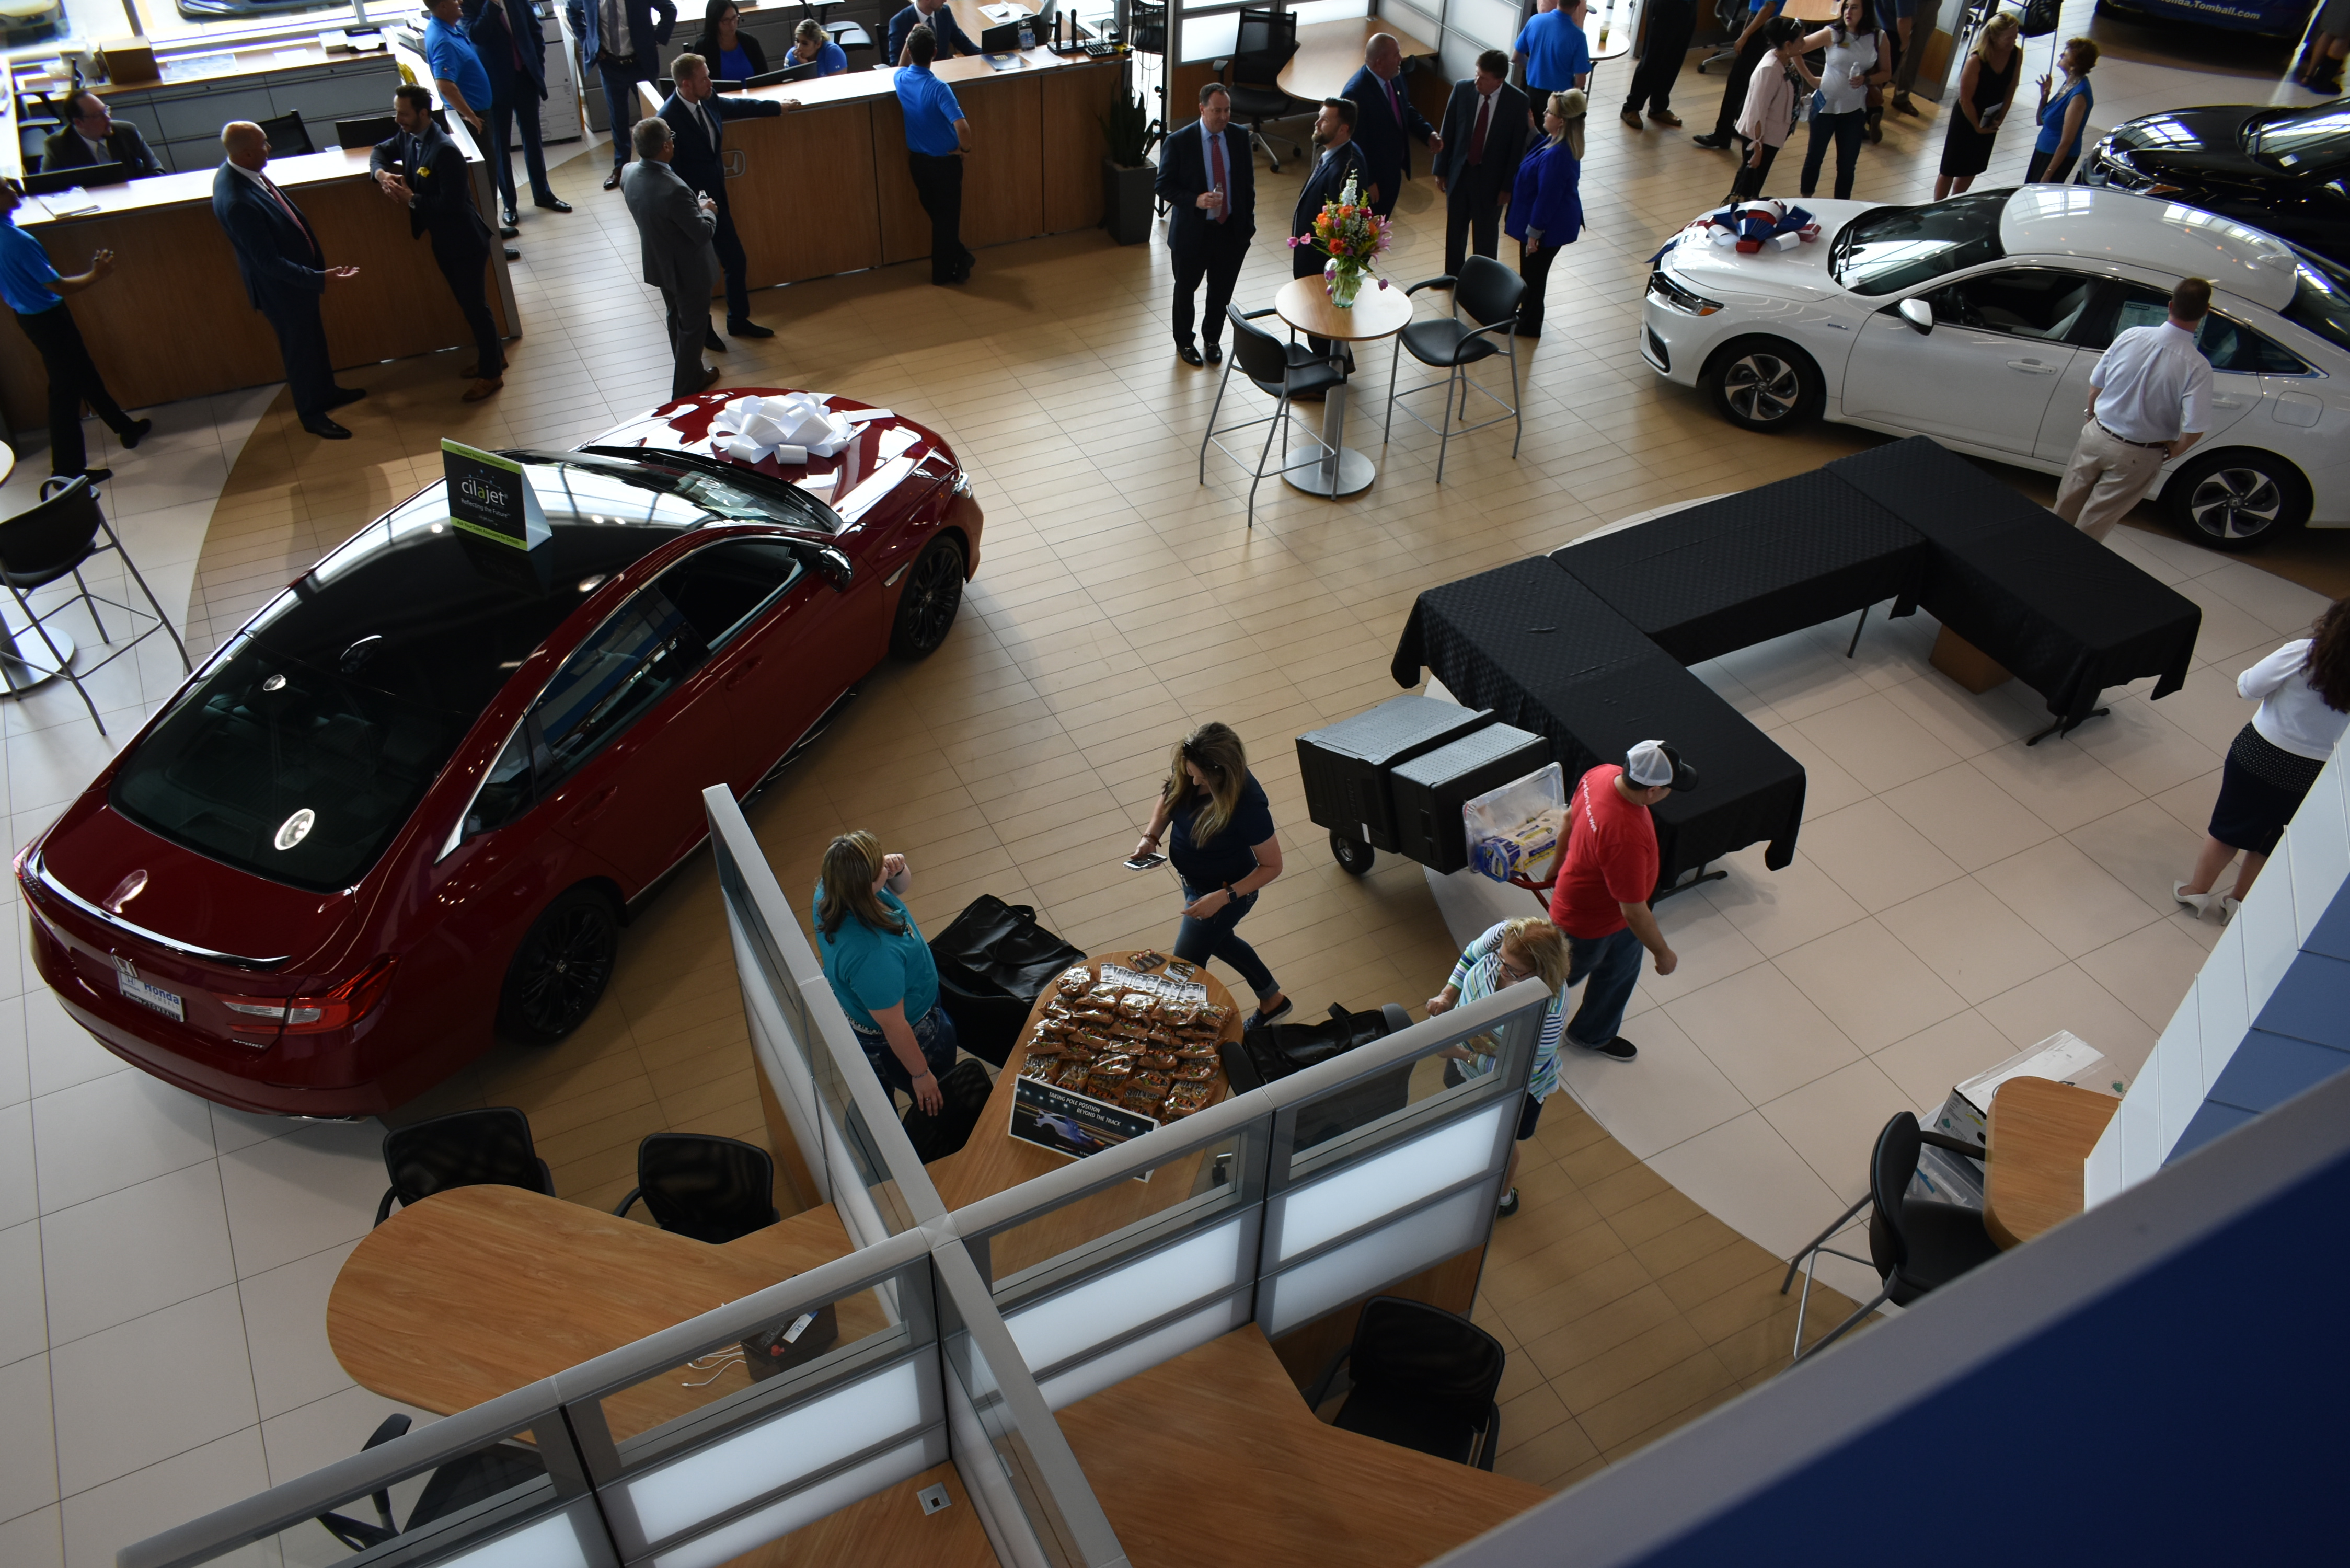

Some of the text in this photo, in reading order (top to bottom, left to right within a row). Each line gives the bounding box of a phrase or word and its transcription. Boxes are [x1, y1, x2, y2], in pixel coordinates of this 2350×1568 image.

[461, 498, 484, 511] Reflecting
[482, 527, 501, 538] Associate
[506, 536, 520, 545] Details
[144, 982, 179, 1005] Honda
[149, 993, 179, 1010] TOMBALL
[126, 992, 142, 1004] Honda
[145, 1001, 180, 1020] TOMBALL
[232, 1039, 265, 1048] SPORT
[1049, 1091, 1101, 1113] TAKING POLE POSITION
[1076, 1108, 1096, 1119] BEYOND
[1105, 1117, 1121, 1127] TRACK
